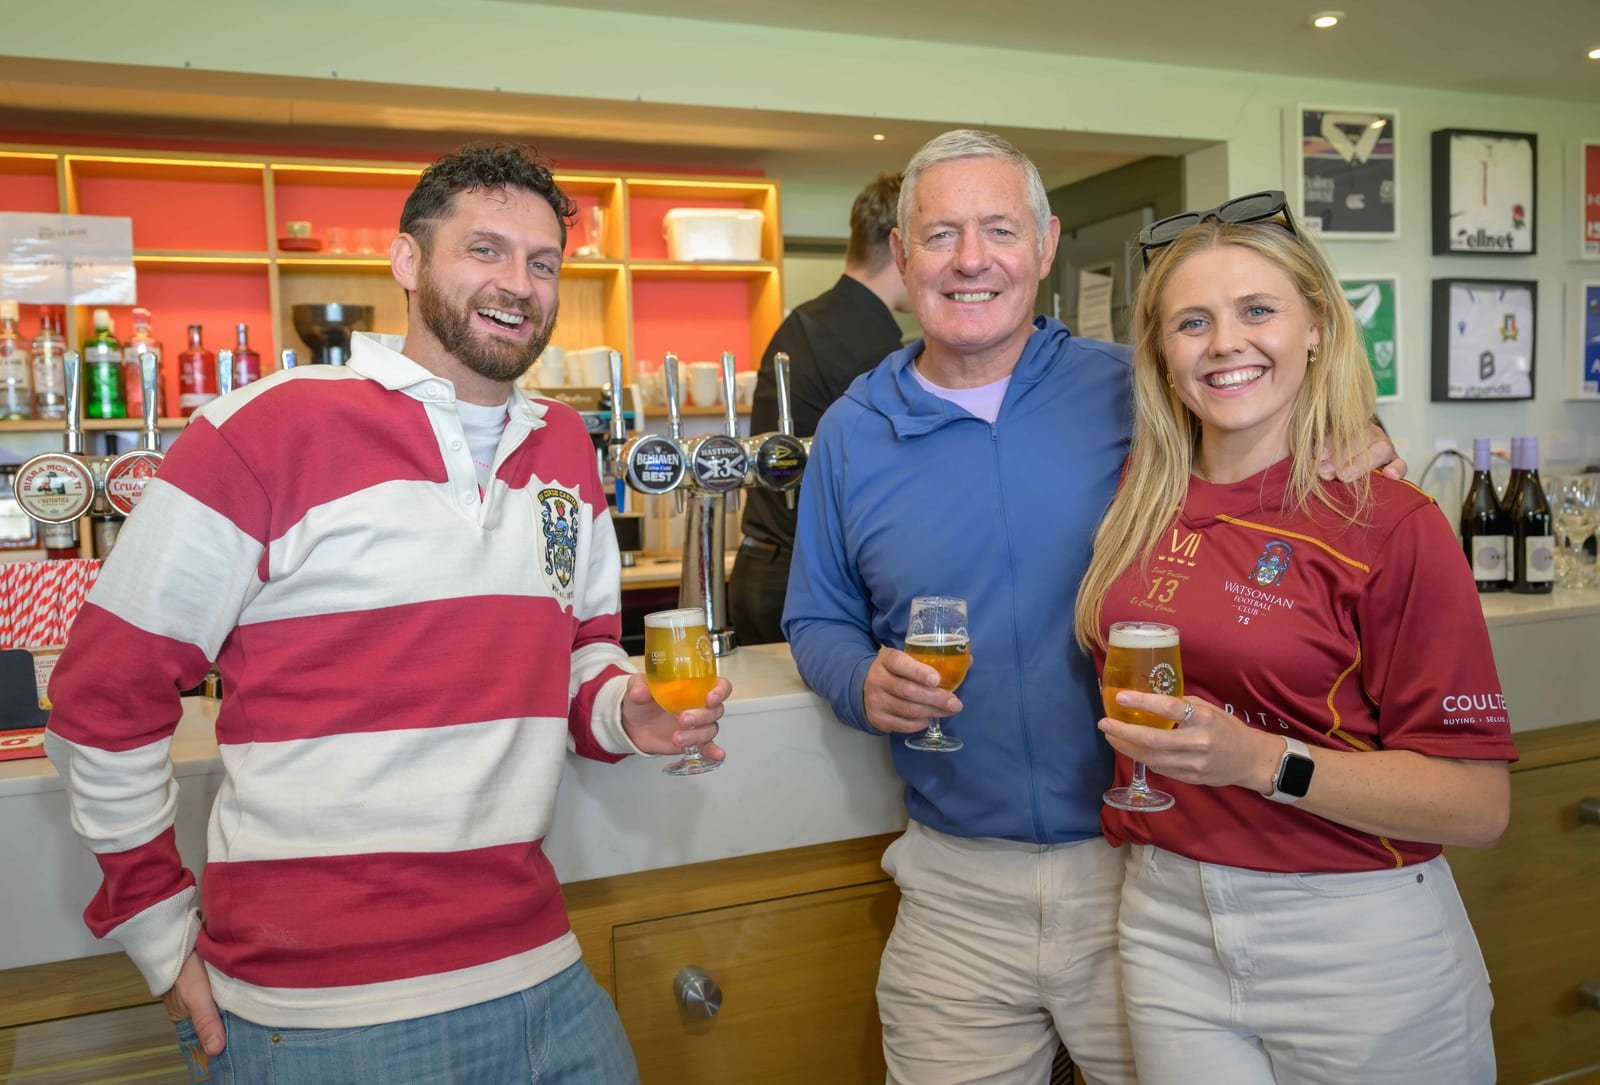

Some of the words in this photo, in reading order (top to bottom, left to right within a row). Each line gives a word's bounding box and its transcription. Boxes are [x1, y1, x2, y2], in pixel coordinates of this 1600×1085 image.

[636, 452, 680, 466] BELHAVEN
[708, 457, 731, 478] 13
[641, 471, 674, 482] BEST
[1171, 529, 1202, 557] VII
[1147, 576, 1180, 603] 13
[1224, 580, 1295, 609] WATSONIAN
[1233, 595, 1272, 611] FOOTBALL
[1237, 604, 1259, 616] CLUB
[1443, 717, 1475, 725] BUYING
